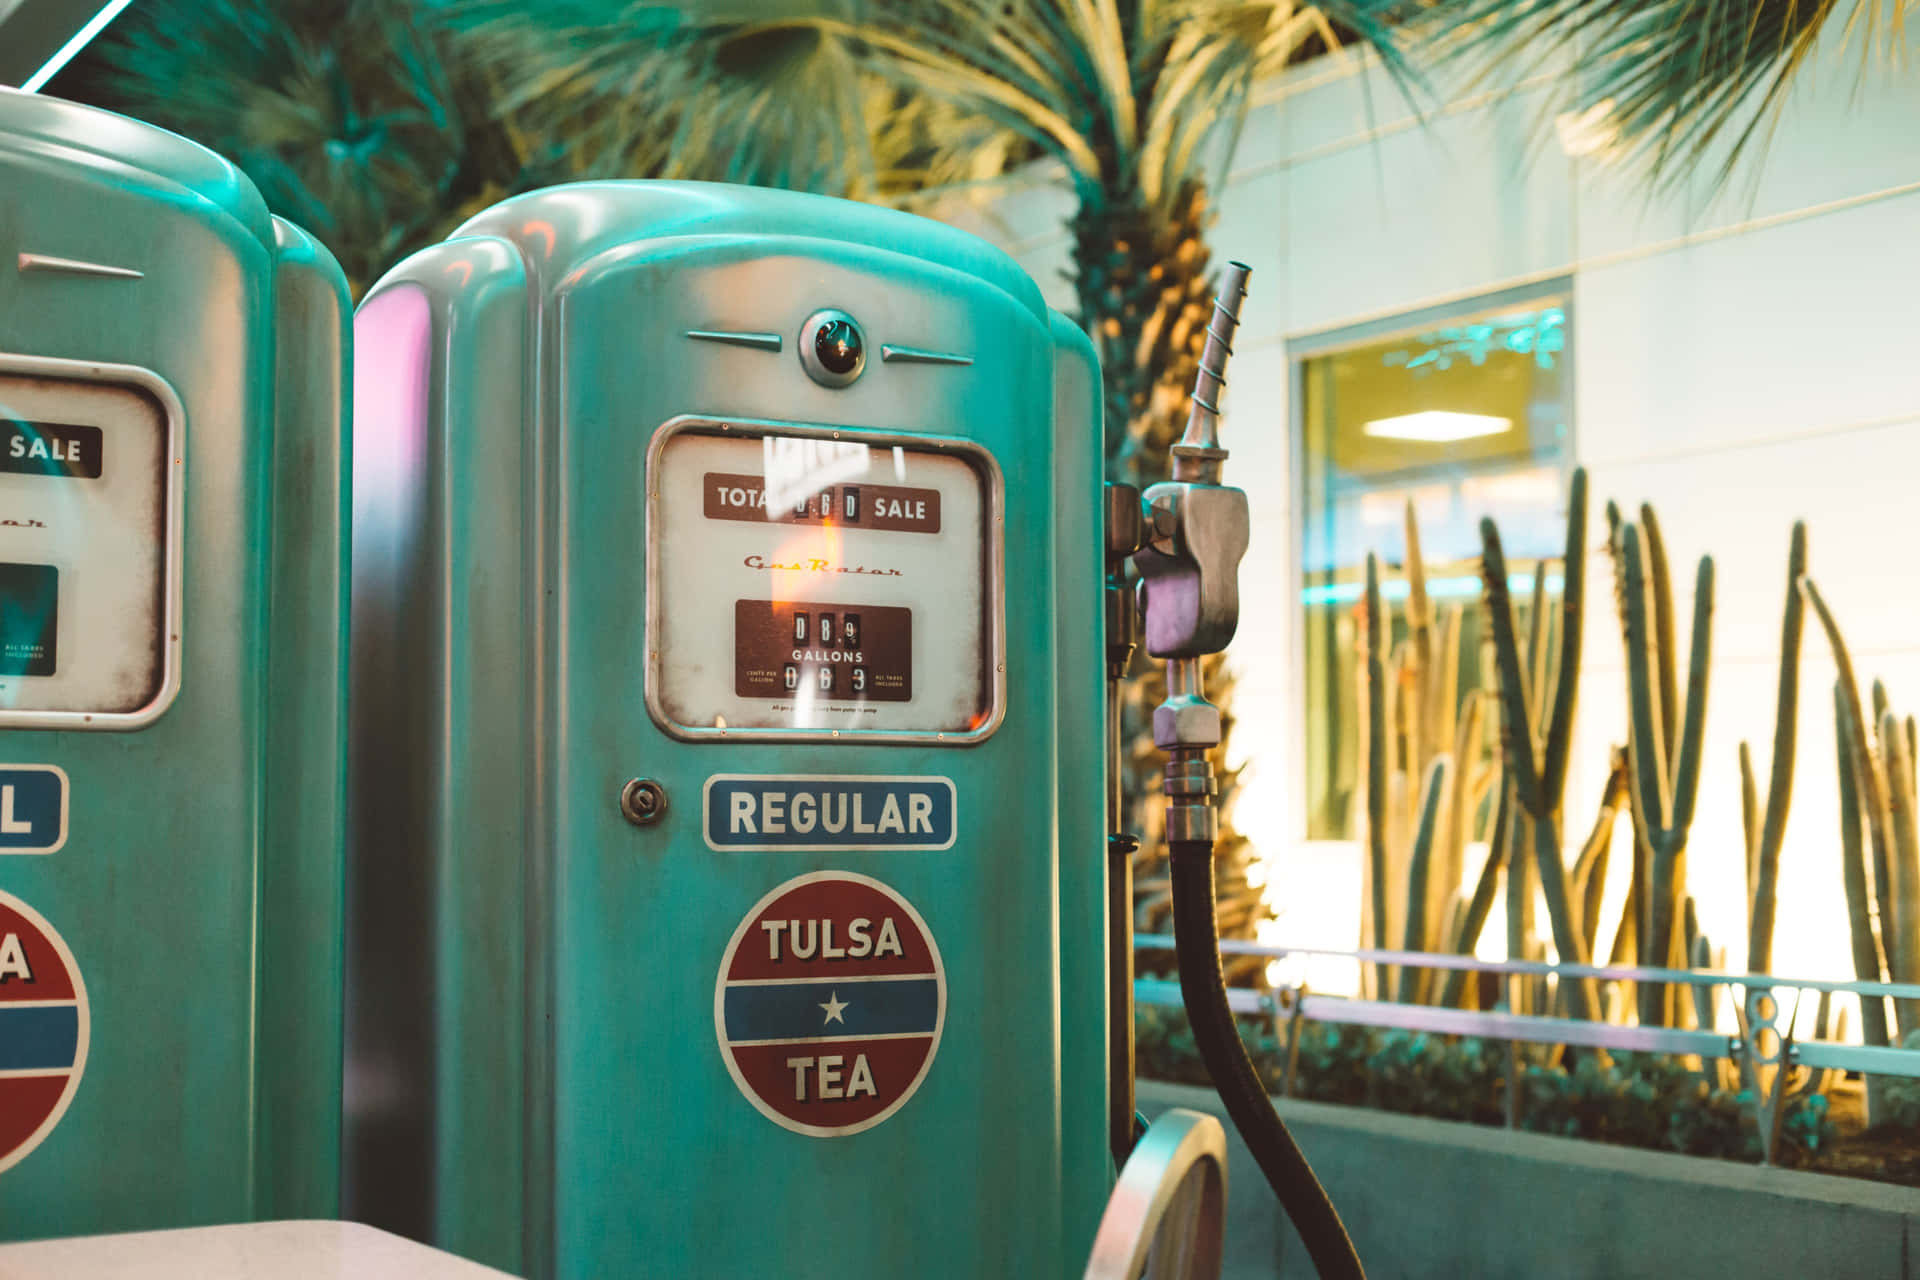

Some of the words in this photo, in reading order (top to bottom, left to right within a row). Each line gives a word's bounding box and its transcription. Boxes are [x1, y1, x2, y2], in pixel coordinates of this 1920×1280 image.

[9, 434, 81, 461] SALE
[717, 487, 769, 509] TOTA
[874, 498, 926, 520] SALE
[792, 649, 864, 663] GALLONS
[729, 791, 935, 834] REGULAR
[761, 917, 905, 961] TULSA
[786, 1053, 878, 1102] TEA
